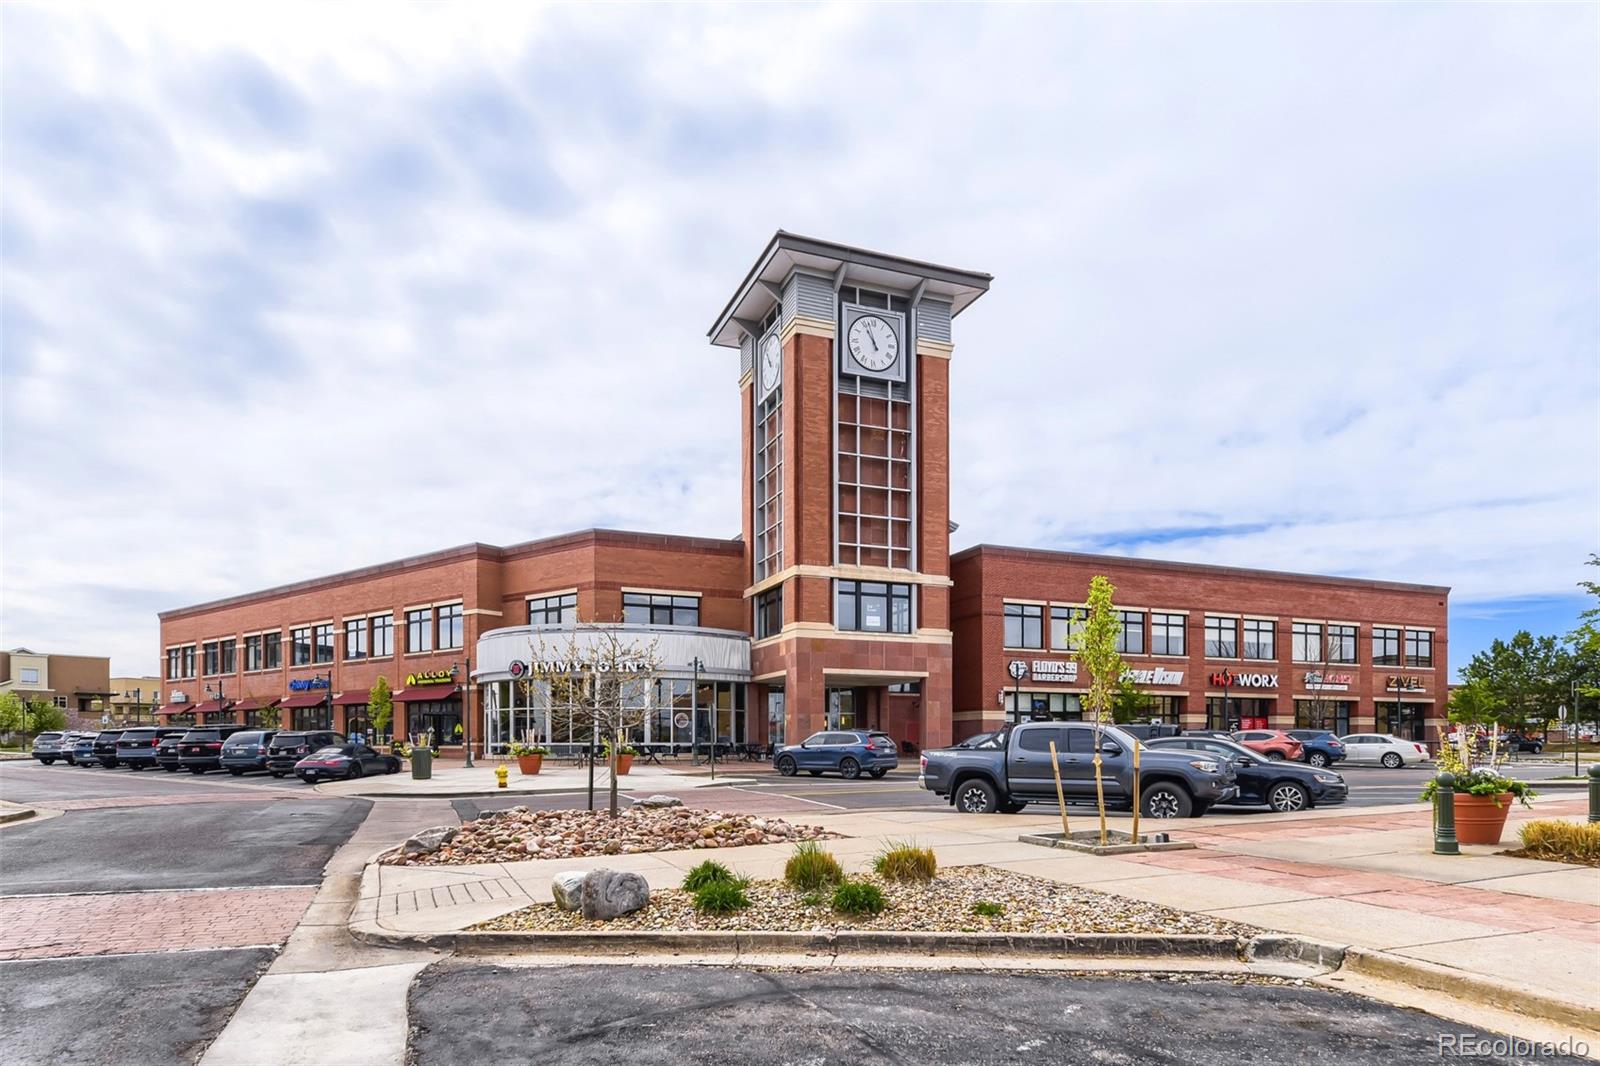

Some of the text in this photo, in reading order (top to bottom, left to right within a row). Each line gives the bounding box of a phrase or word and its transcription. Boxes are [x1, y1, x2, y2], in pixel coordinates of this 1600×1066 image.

[527, 660, 582, 676] JIMMY
[1032, 660, 1078, 674] FLOYD'S 99
[417, 670, 452, 680] ALLOY
[1389, 675, 1425, 689] ZVEL
